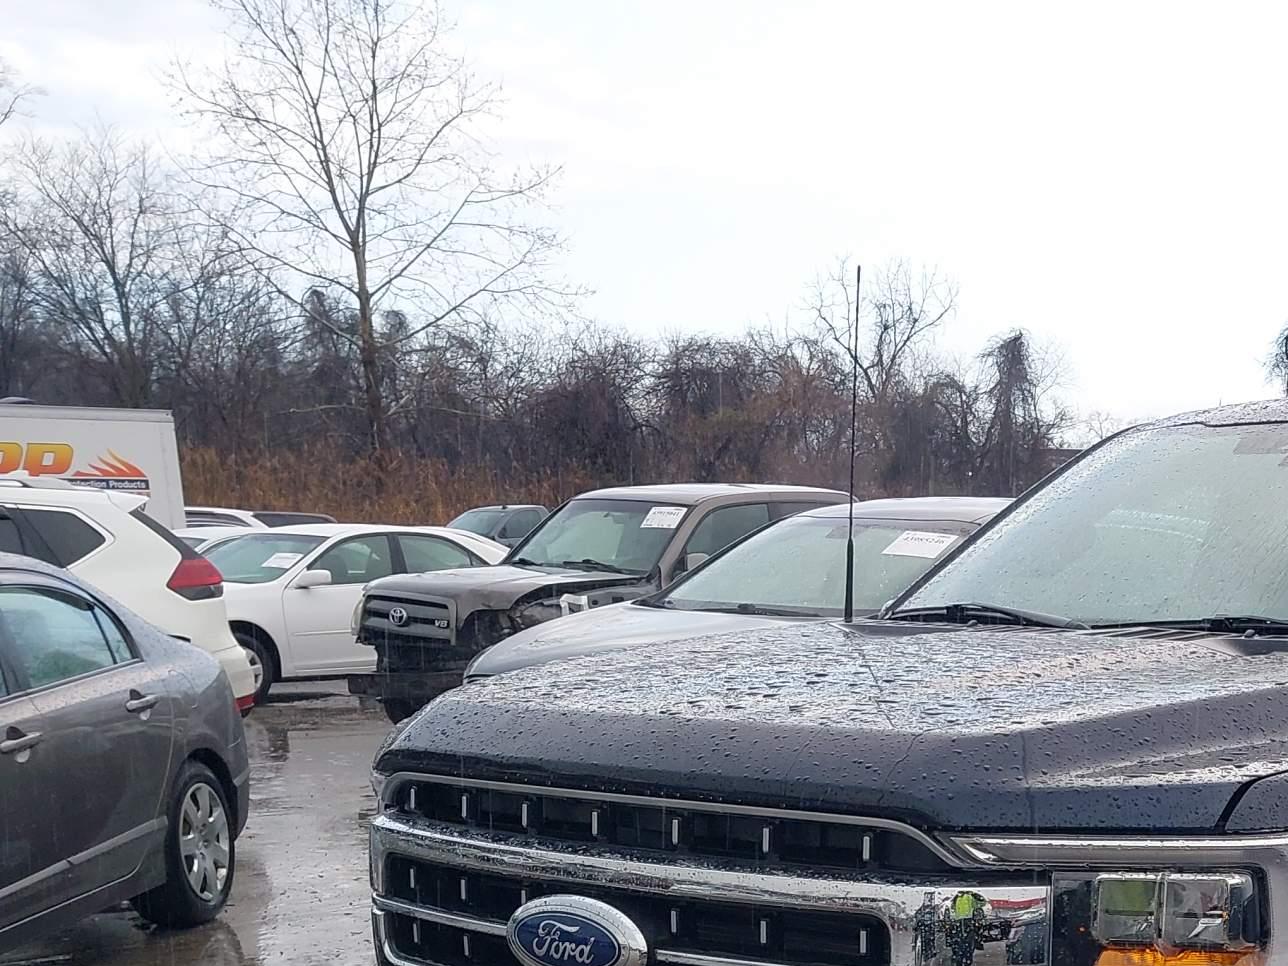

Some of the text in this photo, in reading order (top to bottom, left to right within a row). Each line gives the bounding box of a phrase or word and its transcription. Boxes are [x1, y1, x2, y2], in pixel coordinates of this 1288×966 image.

[70, 480, 146, 489] otection Products
[434, 619, 449, 628] V8
[532, 919, 596, 965] Ford
